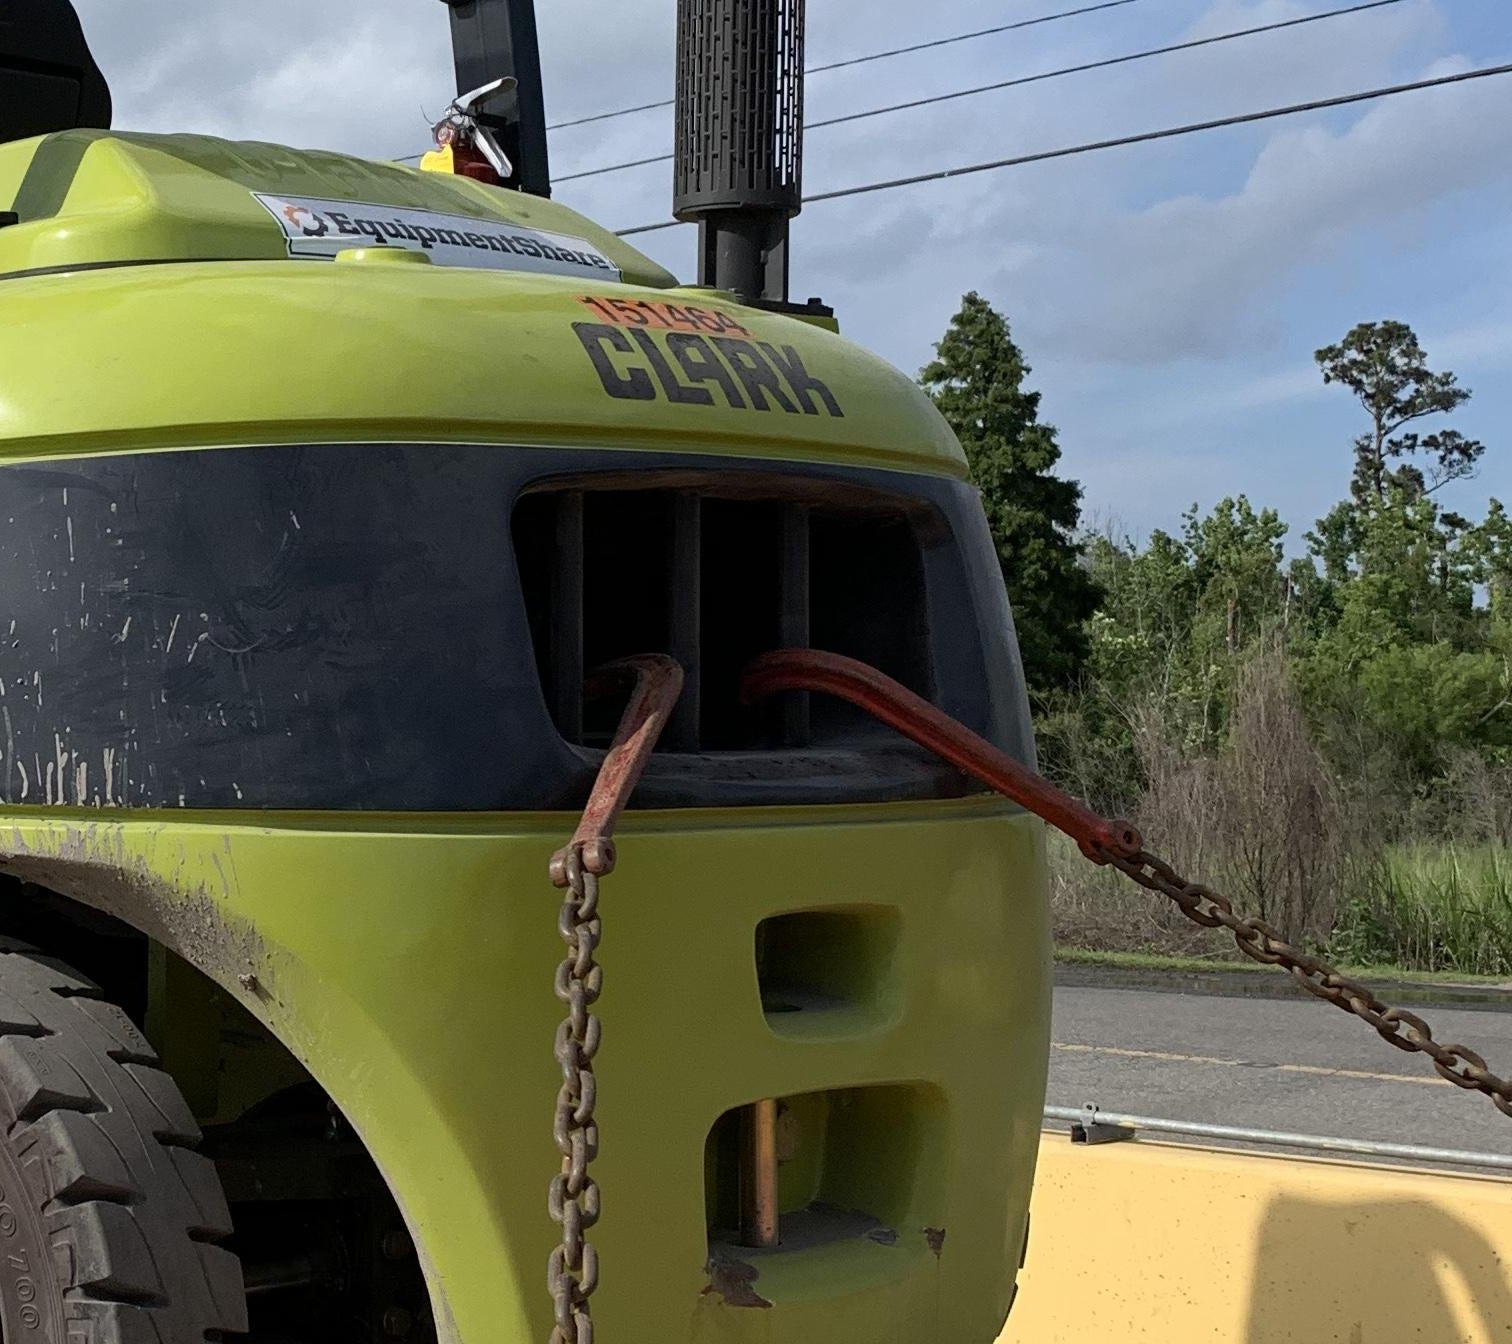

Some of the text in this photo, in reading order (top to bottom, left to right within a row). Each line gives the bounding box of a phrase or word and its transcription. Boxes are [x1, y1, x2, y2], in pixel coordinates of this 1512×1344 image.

[325, 211, 610, 269] EquipmentShare
[581, 296, 750, 337] 151464
[571, 321, 845, 417] CLARK
[7, 1248, 40, 1330] 700
